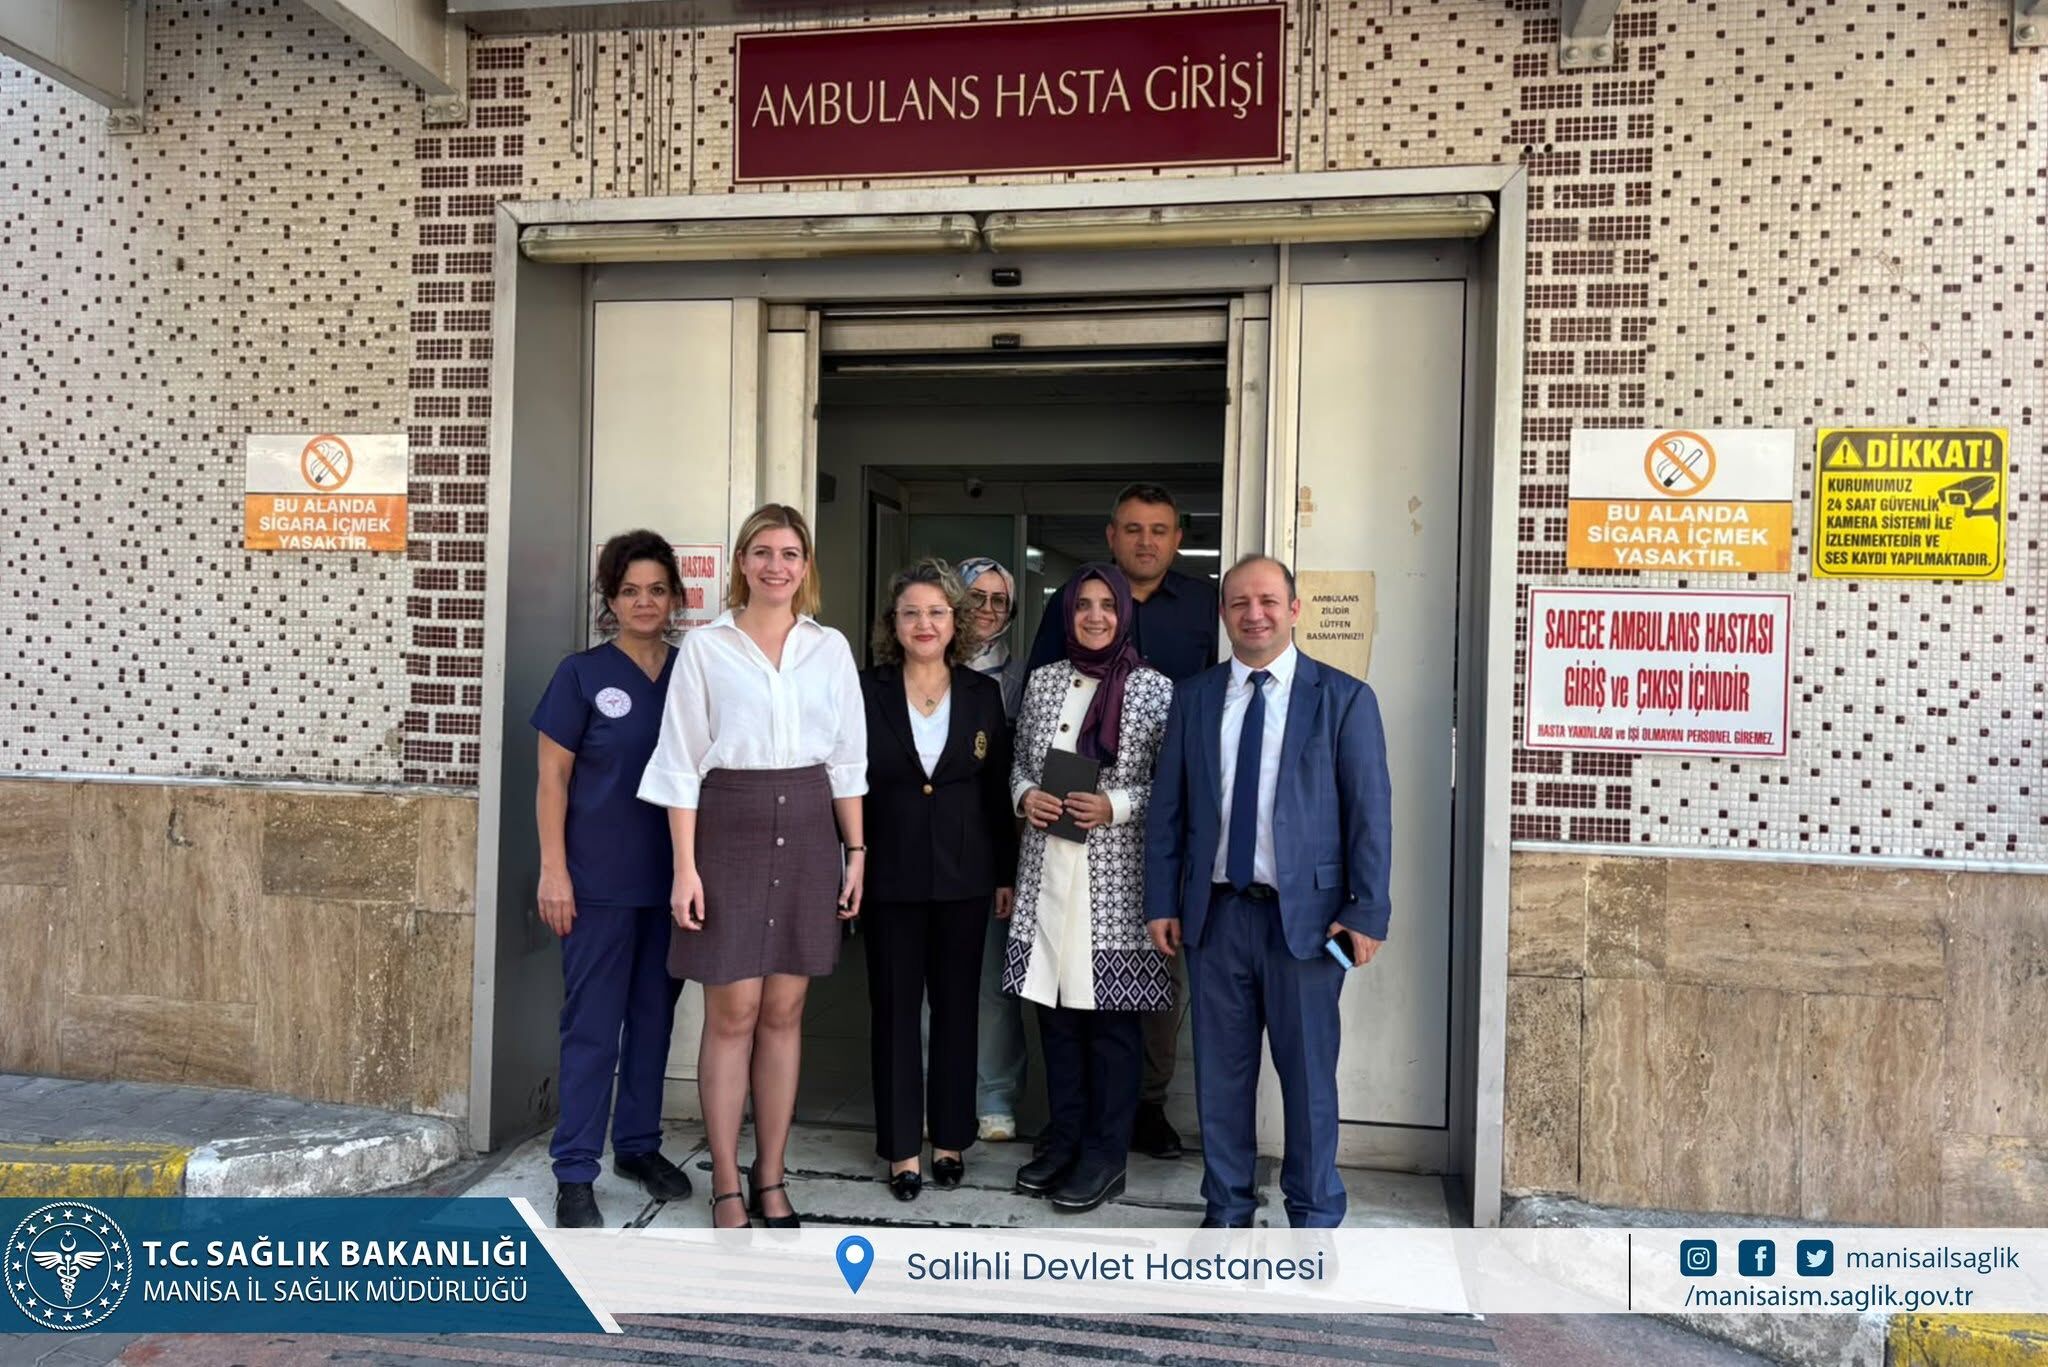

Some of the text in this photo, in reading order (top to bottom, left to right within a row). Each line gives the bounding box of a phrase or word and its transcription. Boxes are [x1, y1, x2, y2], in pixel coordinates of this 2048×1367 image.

[752, 51, 1264, 127] AMBULANS HASTA GİRİŞİ
[1866, 433, 1993, 468] DİKKAT!
[1827, 478, 1912, 492] KURUMUMUZ
[273, 498, 377, 513] BU ALANDA
[1607, 504, 1749, 523] BU ALANDA
[1827, 496, 1939, 512] 24 SAAT GÜVENLİK
[259, 513, 391, 535] SİGARA İÇMEK
[1826, 514, 1953, 530] KAMERA SİSTEMİ İLE
[278, 535, 373, 550] YASAKTIR.
[1587, 520, 1769, 548] SİGARA İÇMEK
[1826, 532, 1939, 547] İZLENMEKTEDİR VE
[682, 556, 714, 577] HASTASI
[1613, 547, 1742, 567] YASAKTIR.
[1825, 552, 1992, 567] SES KAYDI YAPILMAKTADIR.
[1320, 619, 1351, 628] LÜTFEN
[1545, 609, 1774, 654] SADECE AMBULANS HASTASI
[1564, 660, 1750, 716] GİRİŞ ve ÇIKIŞI İÇİNDİR
[1538, 724, 1775, 745] HASTA YAKINLARI ve İŞİ OLMAYAN PERSONEL GİREMEZ.
